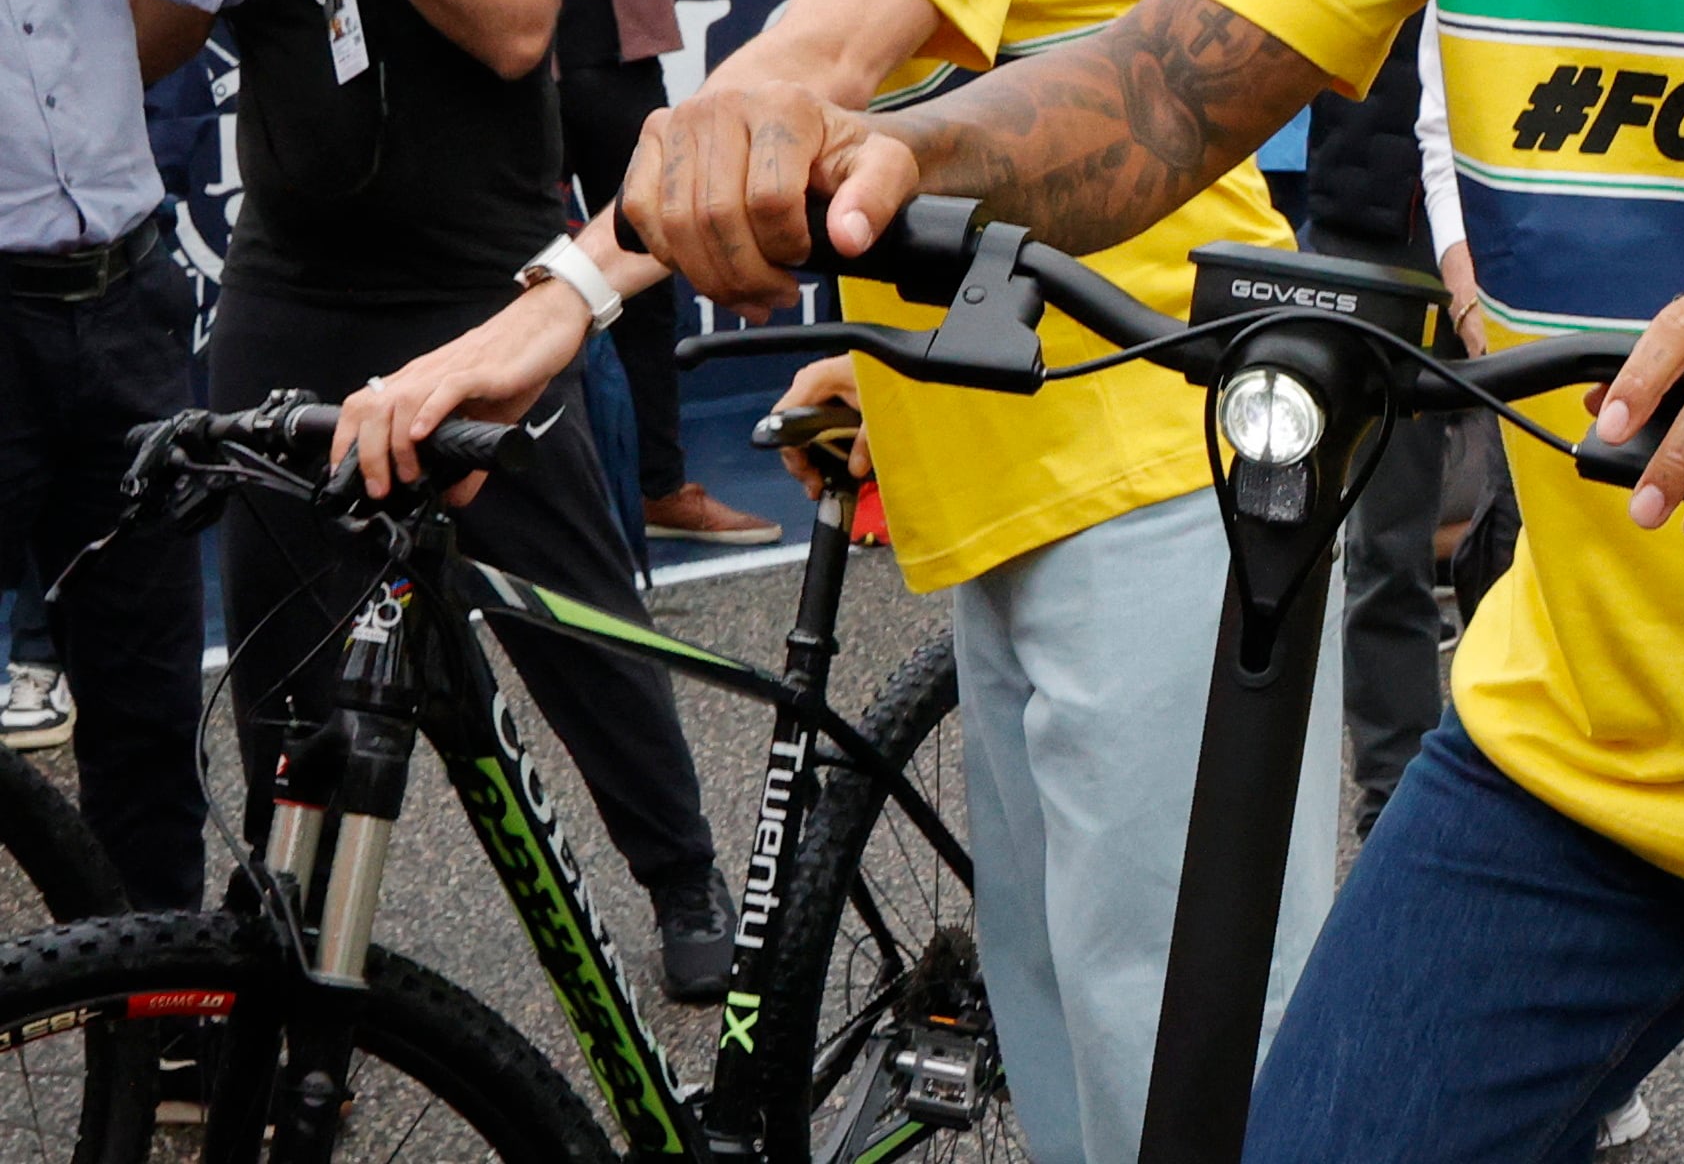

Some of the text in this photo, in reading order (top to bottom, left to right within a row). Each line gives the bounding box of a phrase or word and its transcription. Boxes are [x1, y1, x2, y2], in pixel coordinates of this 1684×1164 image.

[1231, 279, 1358, 313] GOVECS
[149, 993, 225, 1009] DT SWISS
